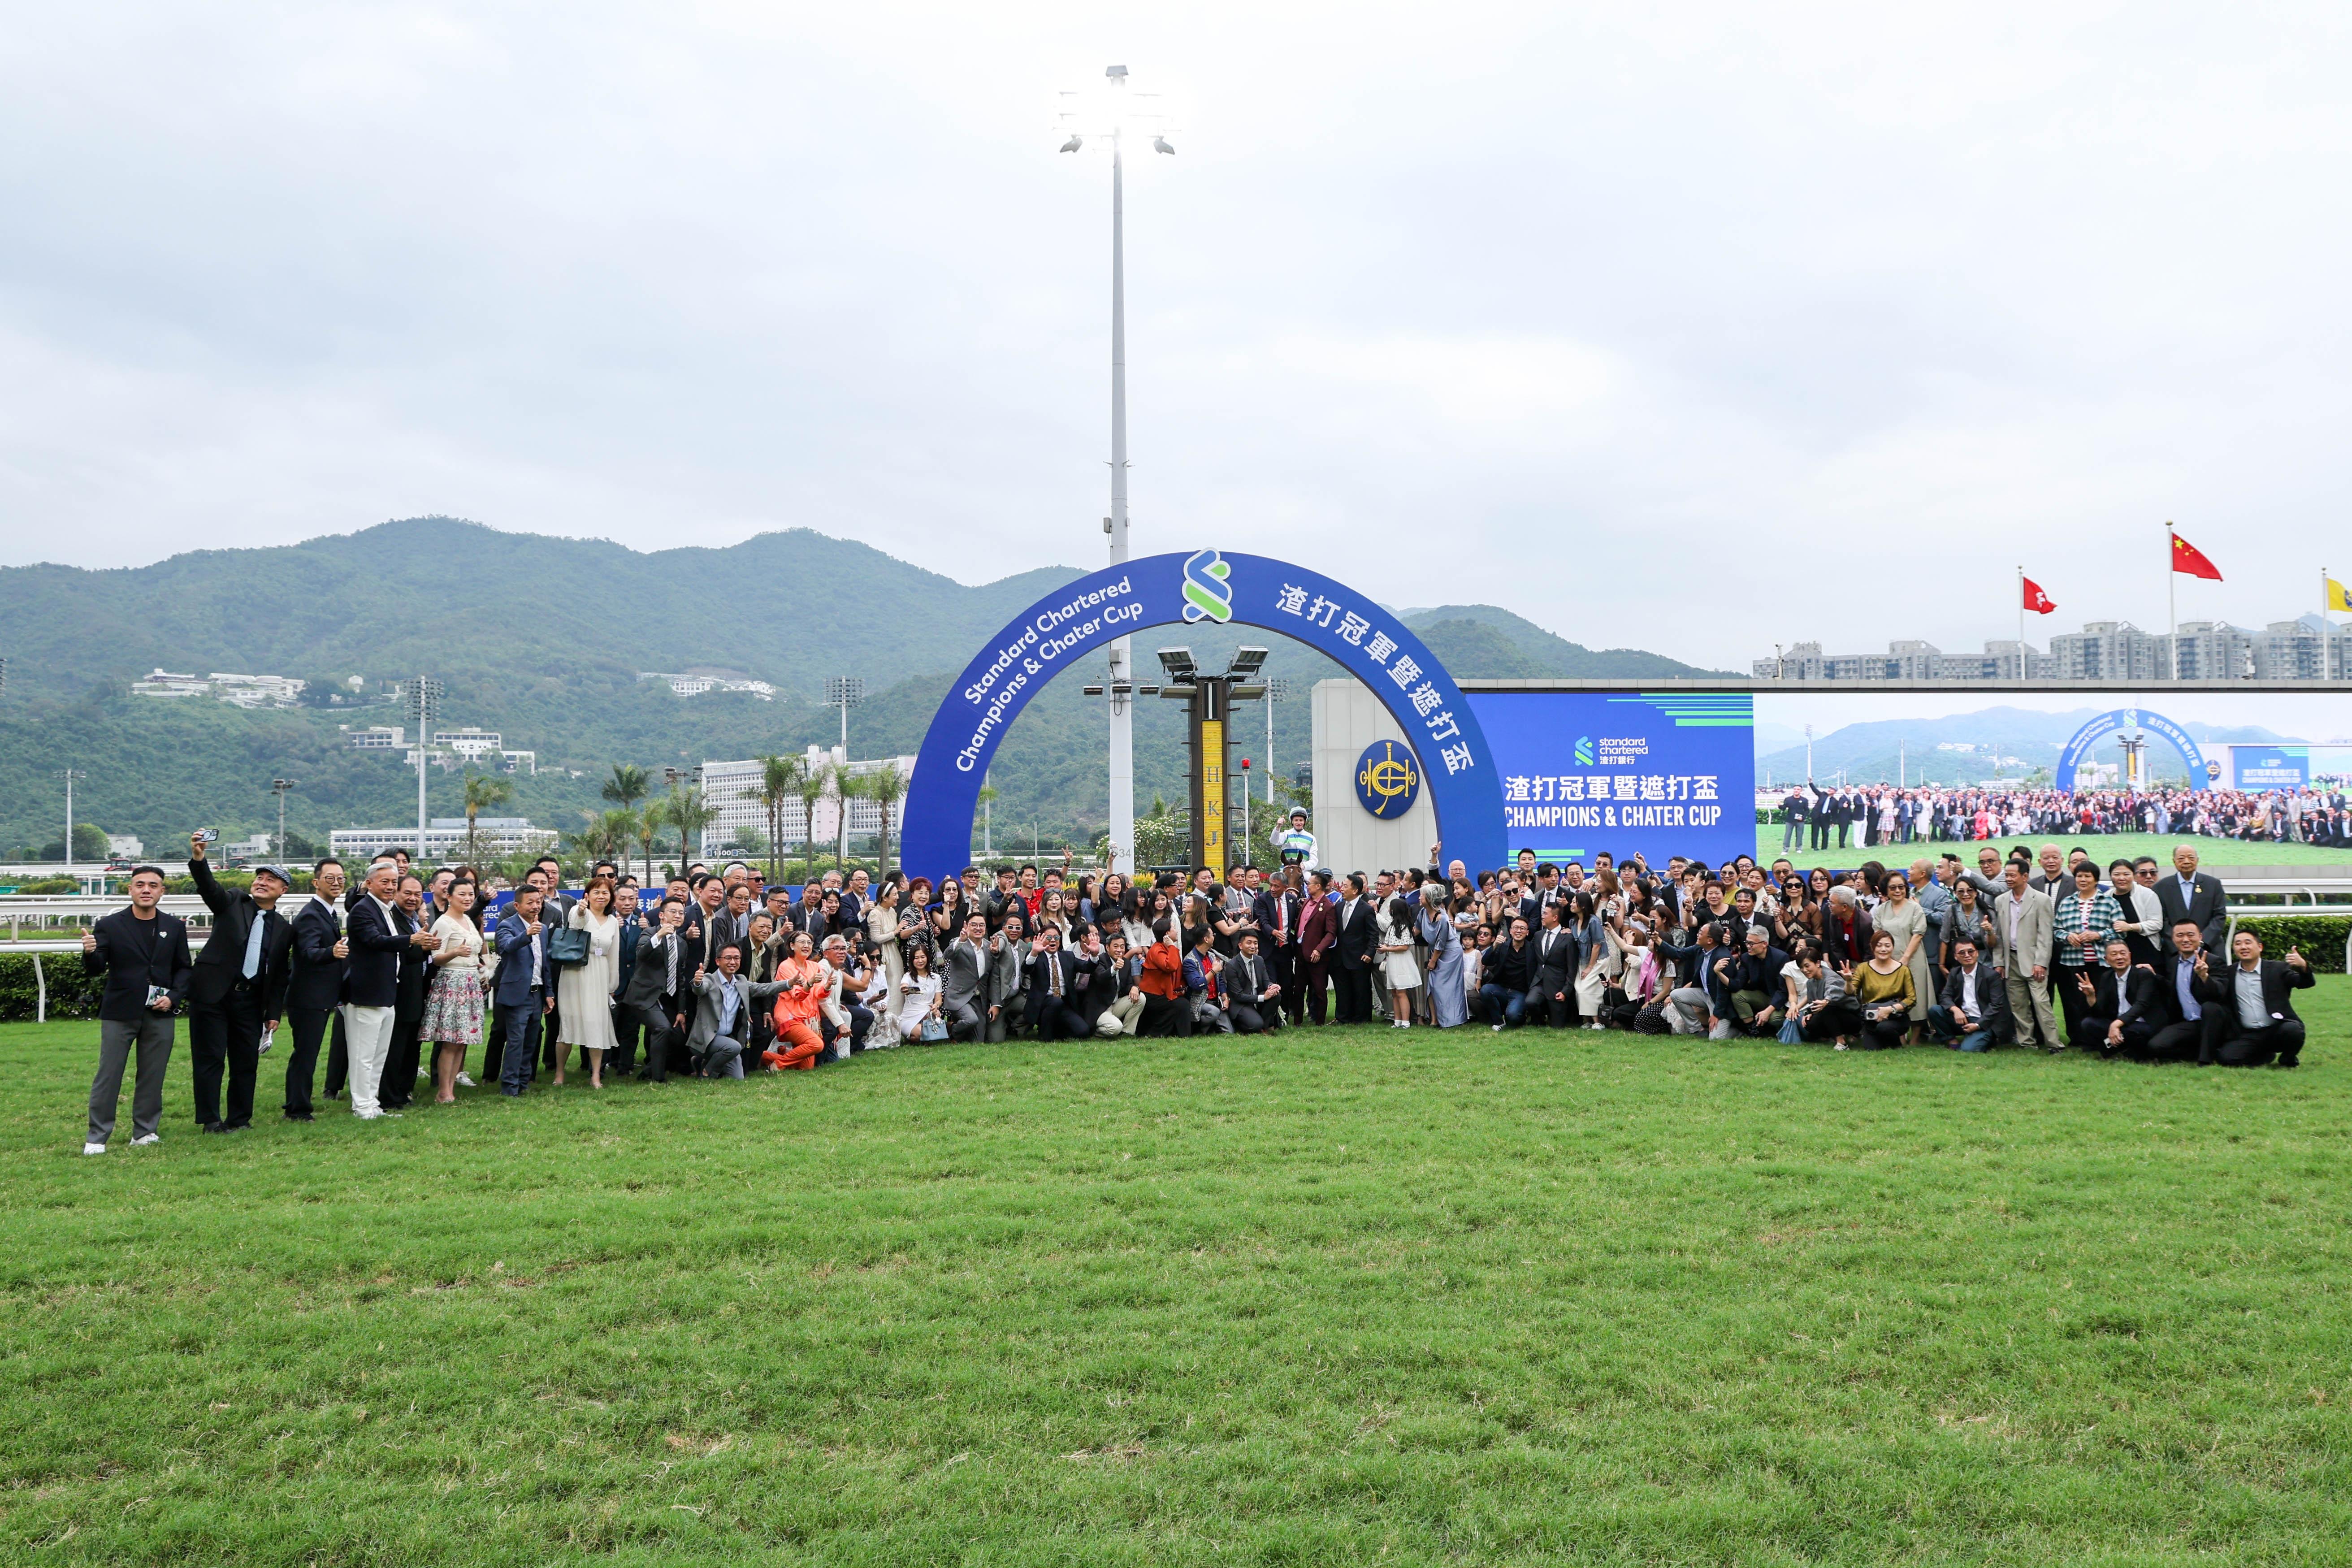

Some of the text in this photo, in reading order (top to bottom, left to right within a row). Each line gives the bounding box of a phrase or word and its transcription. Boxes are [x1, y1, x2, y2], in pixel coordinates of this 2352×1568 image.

[965, 576, 1131, 704] Standard Chartered
[957, 603, 1142, 771] Champions & Chater Cup
[1276, 583, 1474, 775] 渣打冠軍暨遮打盃
[1599, 737, 1645, 746] standard
[1599, 746, 1648, 754] chartered
[1600, 756, 1635, 764] 渣打銀行
[1505, 775, 1718, 801] 渣打冠軍暨遮打盃
[1504, 806, 1721, 827] CHAMPIONS & CHATER CUP
